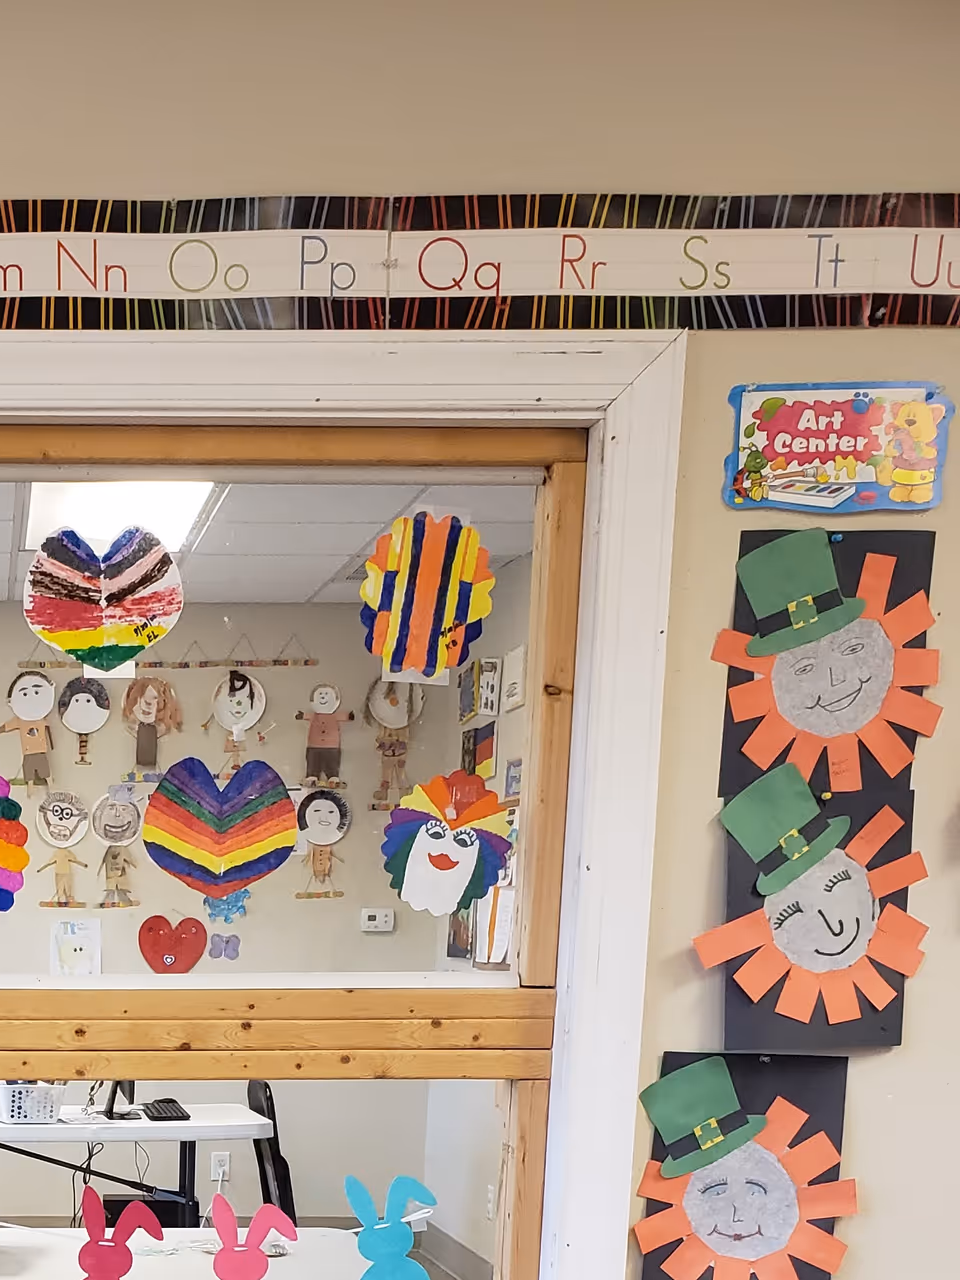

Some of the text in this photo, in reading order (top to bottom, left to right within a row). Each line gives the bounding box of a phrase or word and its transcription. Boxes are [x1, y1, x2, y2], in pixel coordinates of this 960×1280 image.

[56, 239, 127, 293] Nn
[168, 239, 250, 293] Oo
[298, 236, 357, 297] Pp
[418, 236, 508, 309] Qq
[559, 234, 607, 290] Rr
[679, 235, 731, 291] Ss
[807, 234, 846, 288] Tt
[797, 409, 845, 431] Art
[773, 433, 869, 453] Center
